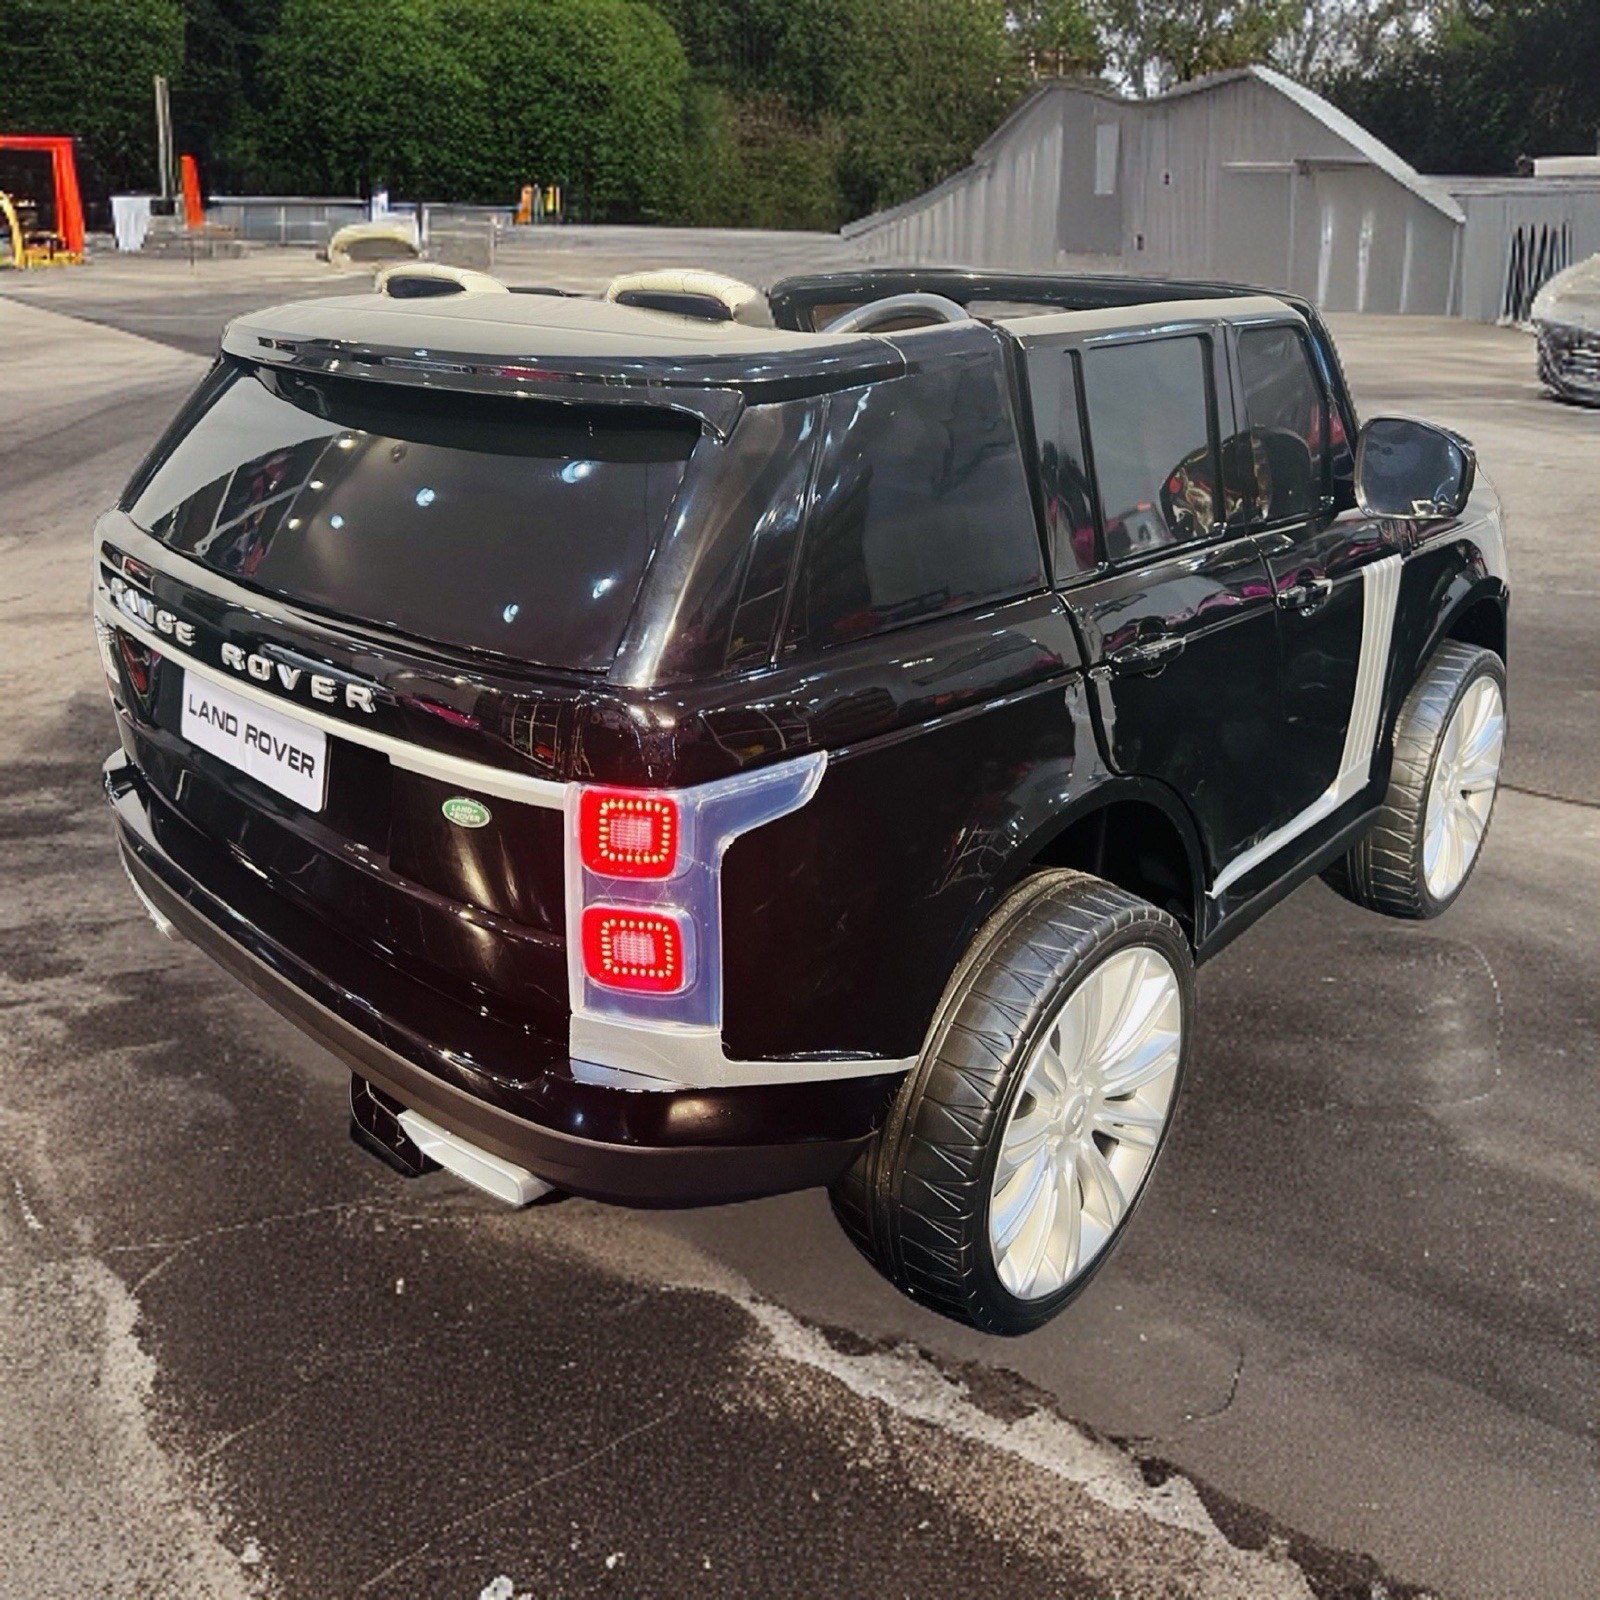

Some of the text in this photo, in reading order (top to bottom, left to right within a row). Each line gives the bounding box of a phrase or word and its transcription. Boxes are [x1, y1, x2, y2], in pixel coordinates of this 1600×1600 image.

[220, 642, 377, 713] ROVER
[187, 693, 316, 779] LAND ROVER
[451, 804, 473, 815] LAND
[454, 813, 481, 823] ROVER
